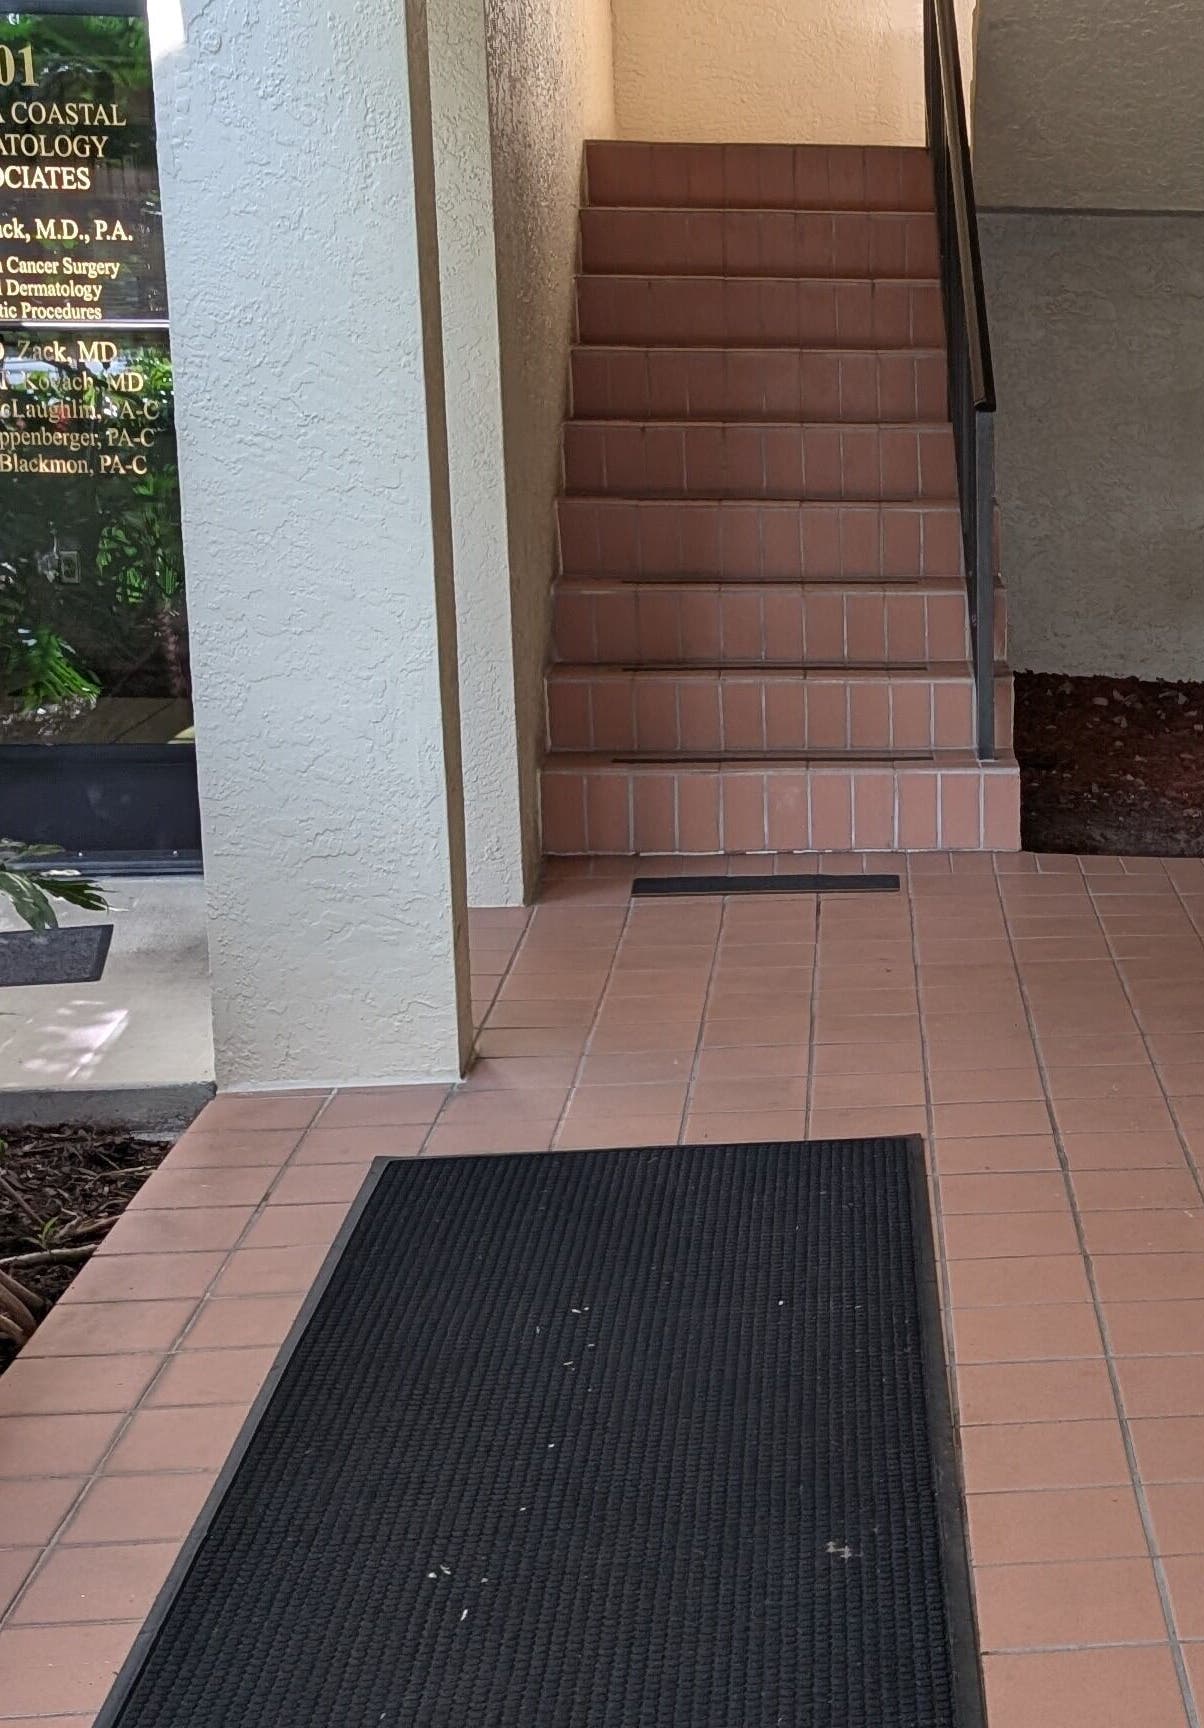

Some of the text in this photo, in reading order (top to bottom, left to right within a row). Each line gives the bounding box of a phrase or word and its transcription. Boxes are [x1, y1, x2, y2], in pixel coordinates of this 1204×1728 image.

[11, 101, 127, 126] COASTAL
[0, 217, 133, 244] ck, M.D., P.A.
[6, 256, 59, 274] Cancer
[62, 256, 121, 279] Surgery
[5, 279, 103, 301] Dermatology
[21, 301, 103, 320] Procedures
[77, 341, 118, 363] MD
[107, 372, 144, 392] MD
[106, 428, 155, 448] PA-C
[100, 454, 148, 475] PA-C
